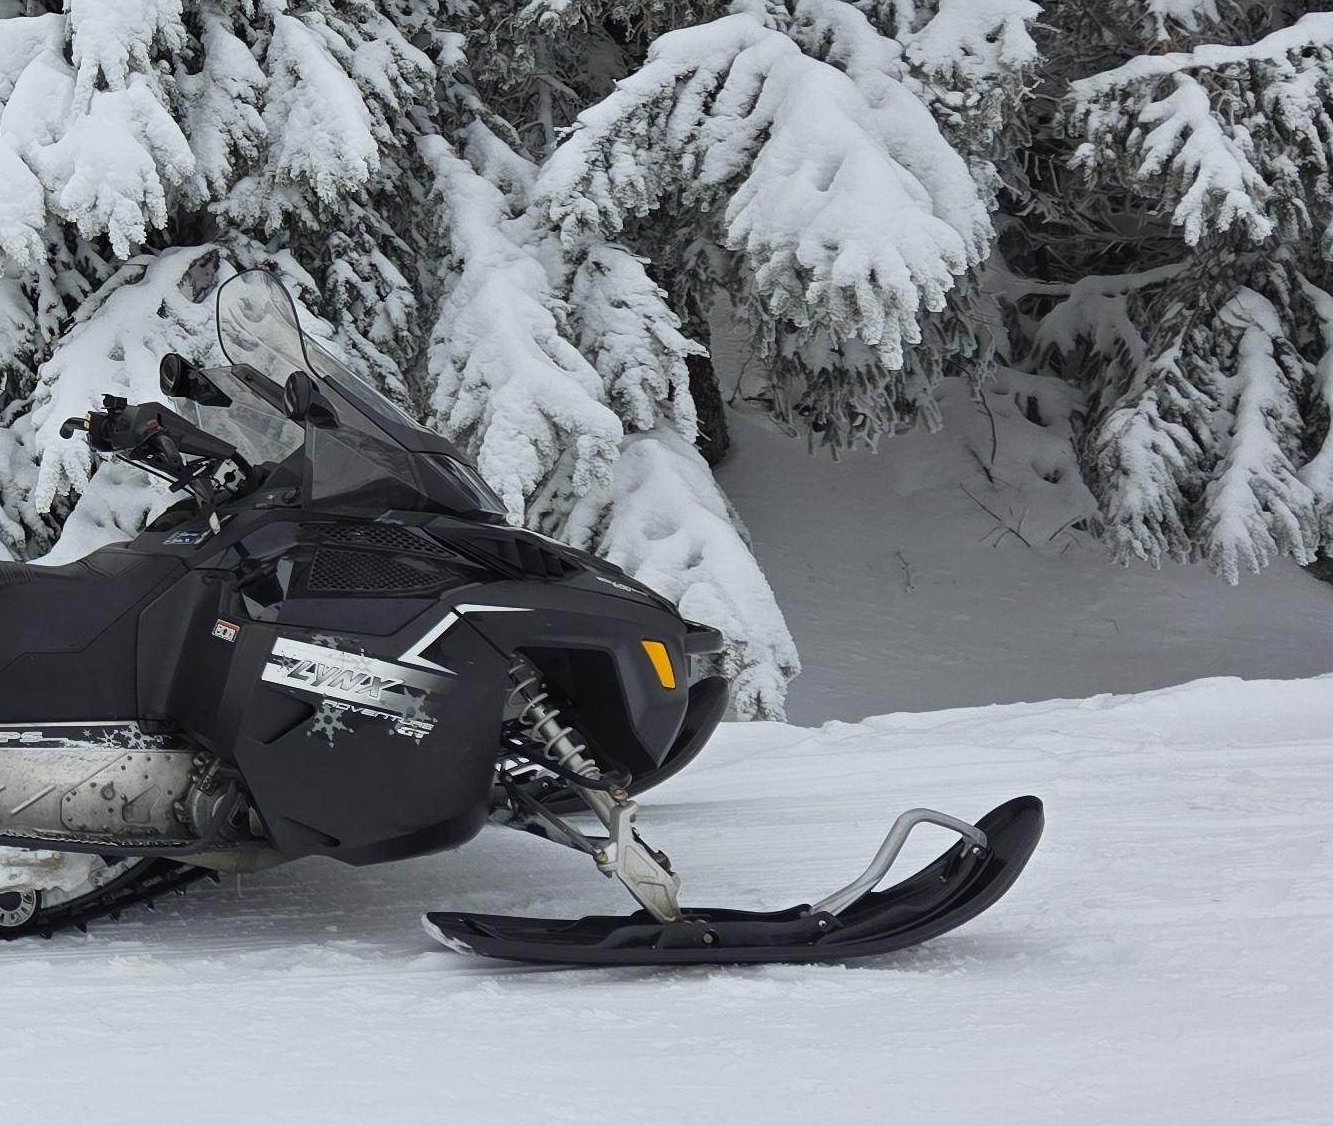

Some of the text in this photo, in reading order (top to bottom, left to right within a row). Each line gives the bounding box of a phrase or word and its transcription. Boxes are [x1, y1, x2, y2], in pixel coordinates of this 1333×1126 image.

[286, 659, 405, 699] LYNX
[322, 699, 435, 731] ADVENTURE
[396, 725, 430, 739] GT
